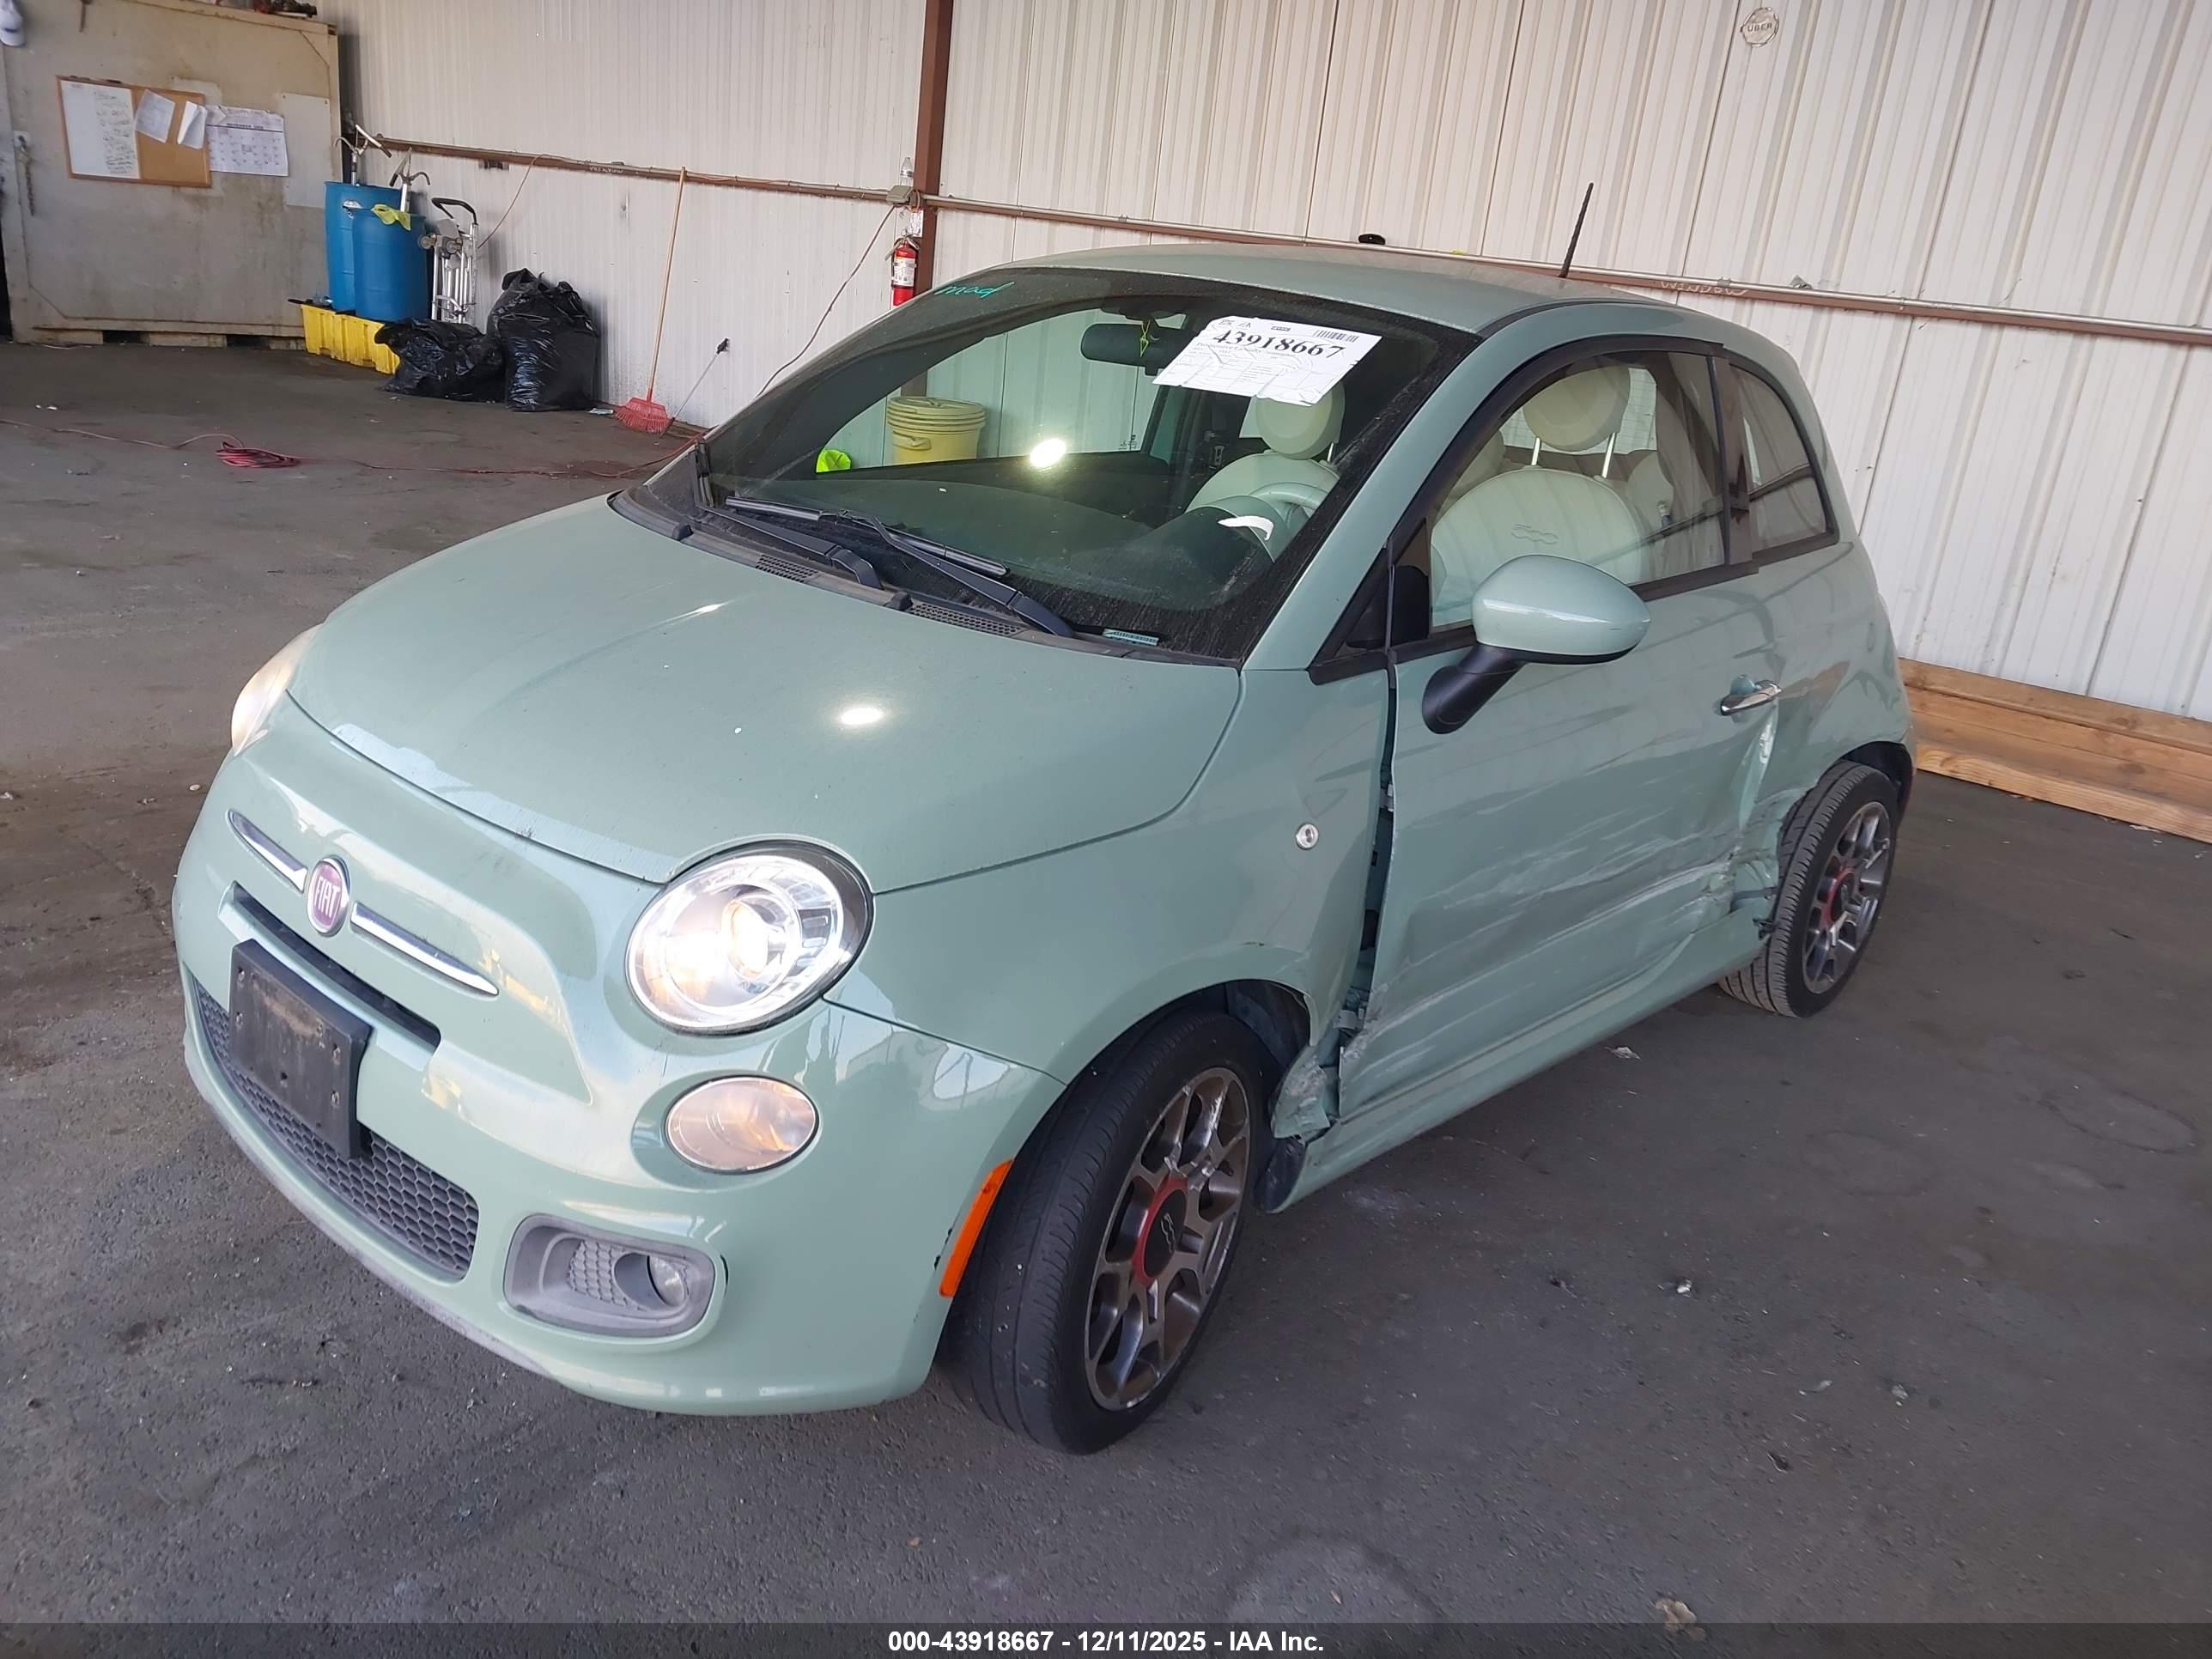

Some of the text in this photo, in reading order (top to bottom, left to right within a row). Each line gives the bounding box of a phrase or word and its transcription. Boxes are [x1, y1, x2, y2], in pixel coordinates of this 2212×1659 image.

[1747, 22, 1773, 33] UBER
[1212, 329, 1346, 359] 43918667
[314, 876, 341, 919] FIAT
